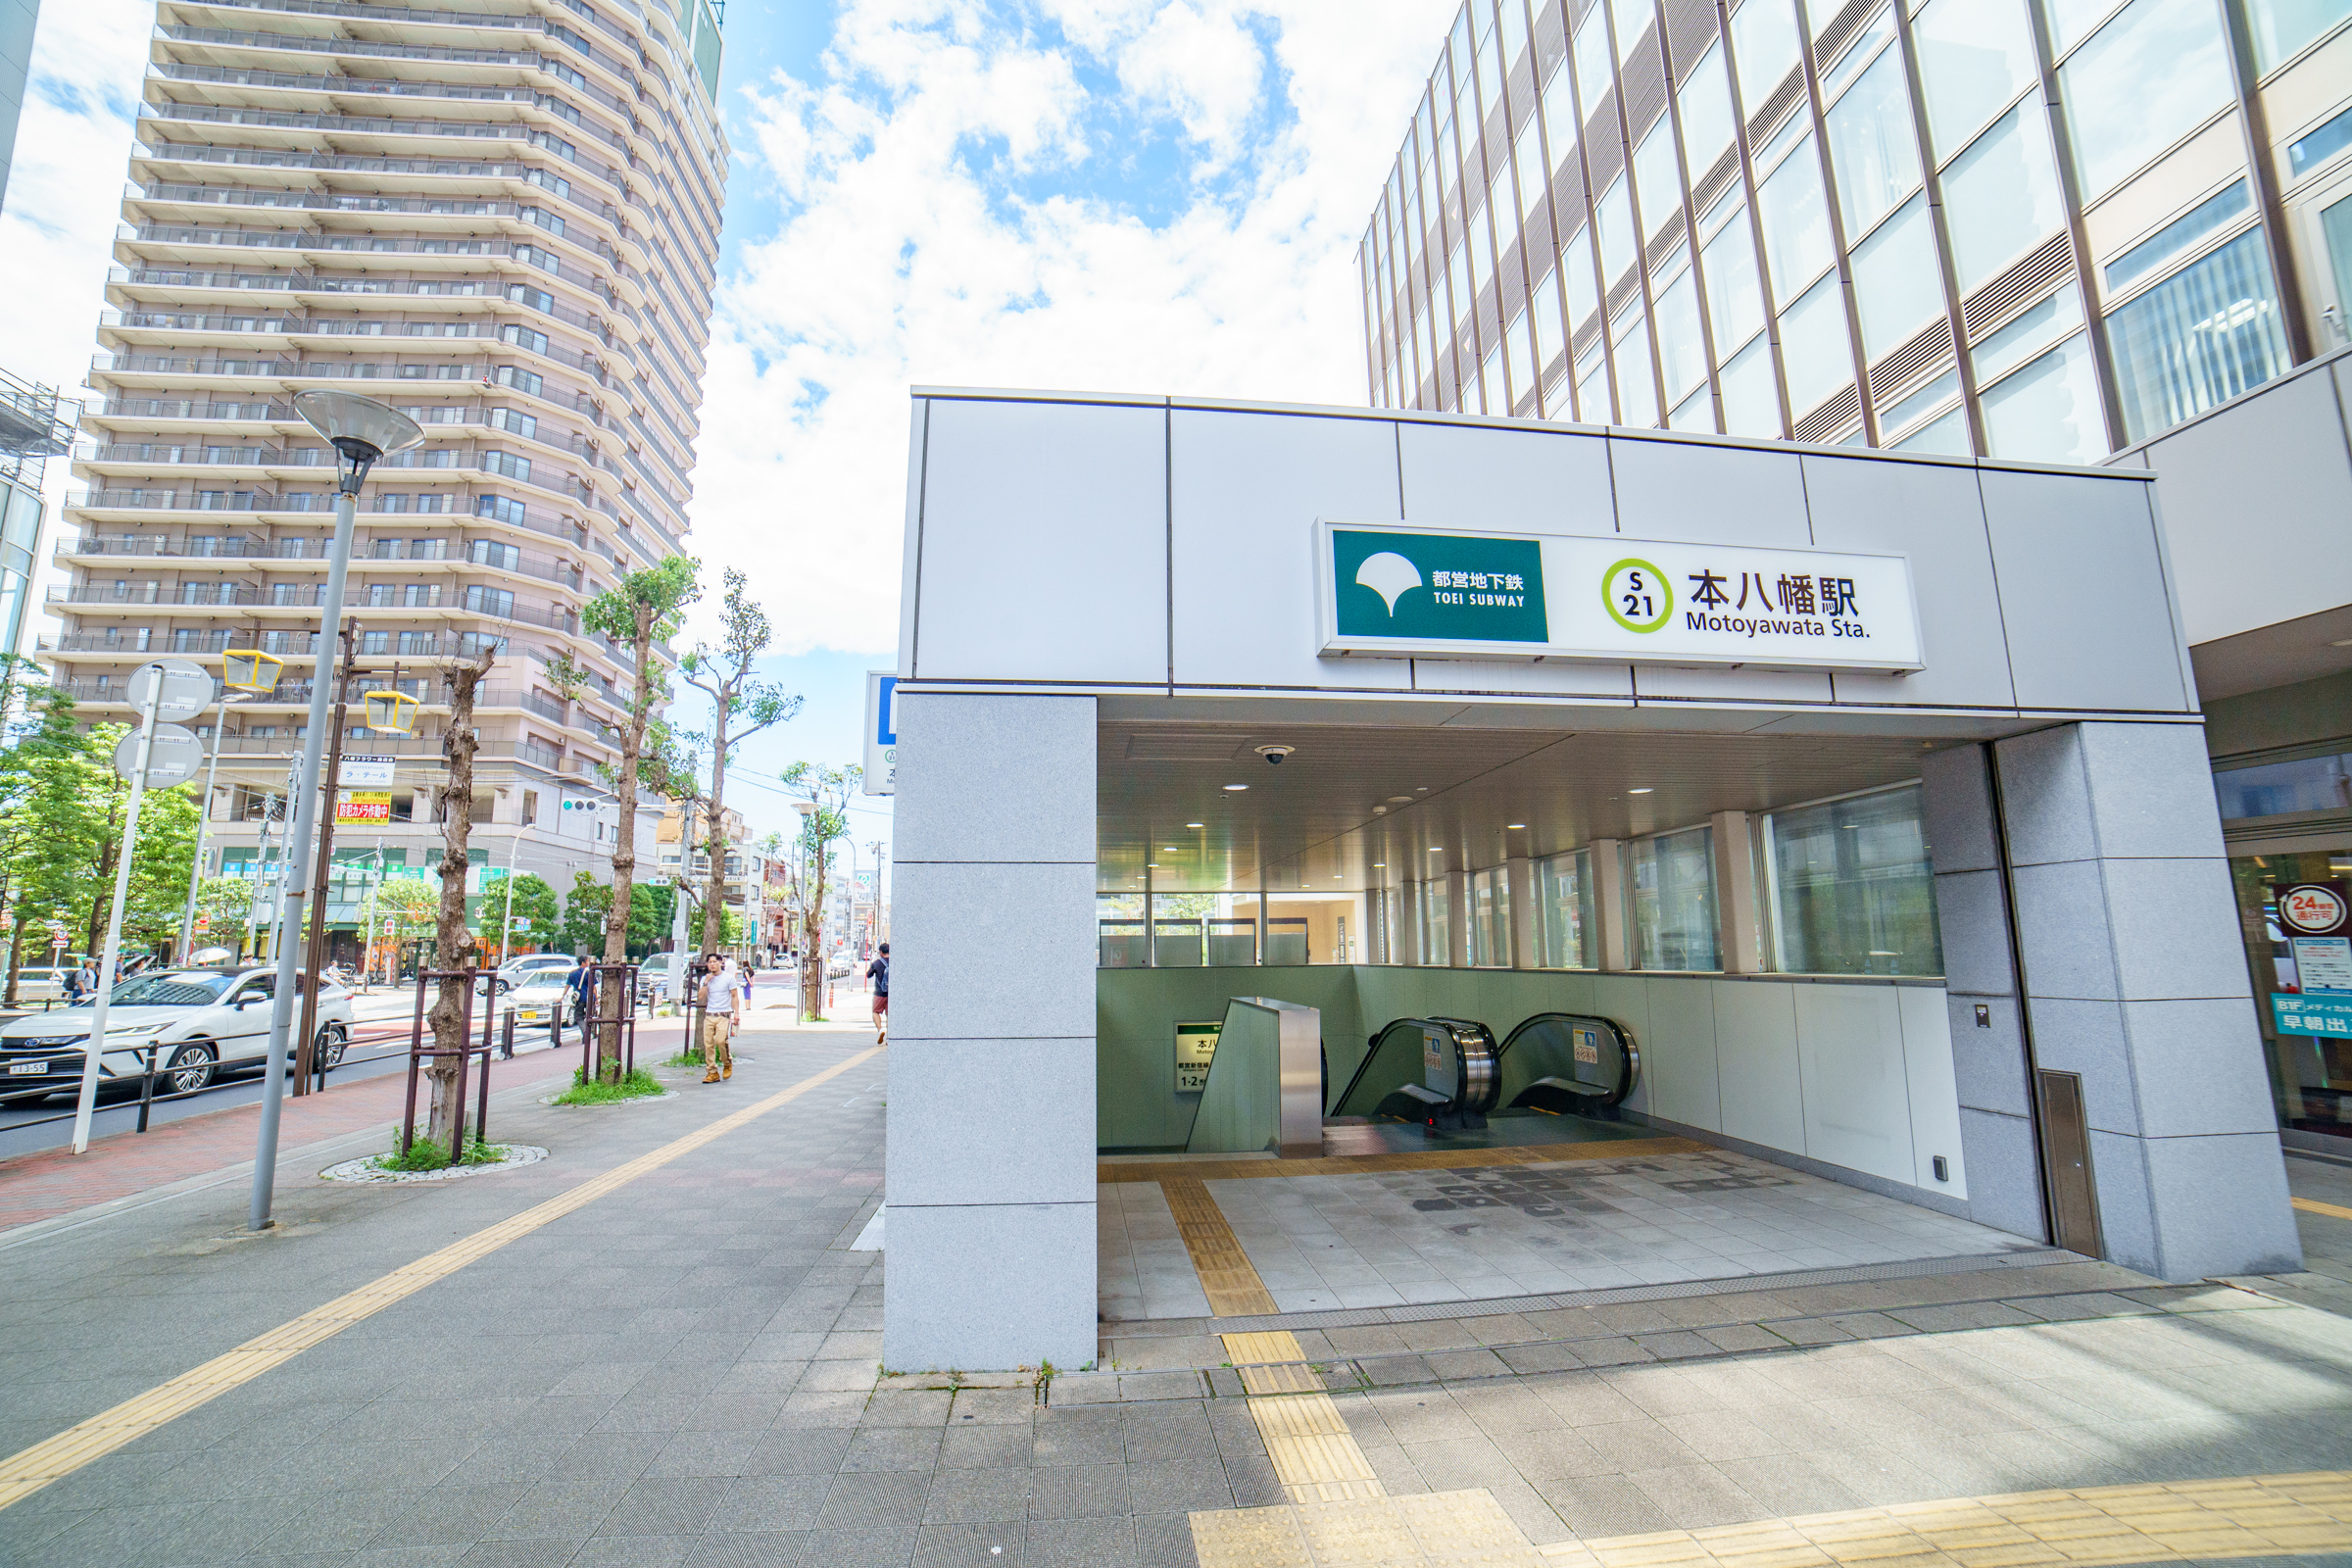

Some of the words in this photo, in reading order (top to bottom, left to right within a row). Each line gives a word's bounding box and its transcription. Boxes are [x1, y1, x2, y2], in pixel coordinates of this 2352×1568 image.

[1432, 570, 1524, 591] 都営地下鉄
[1629, 571, 1643, 591] S
[1433, 591, 1464, 605] TOEI
[1469, 593, 1525, 608] SUBWAY
[1688, 568, 1859, 616] 本八幡駅
[1623, 594, 1653, 616] 21
[1686, 612, 1825, 638] Motoyawata
[1832, 618, 1871, 638] Sta.
[338, 804, 388, 818] 防犯カメラ作動中
[2278, 1001, 2303, 1011] B1F
[2283, 1015, 2352, 1033] 早朝出
